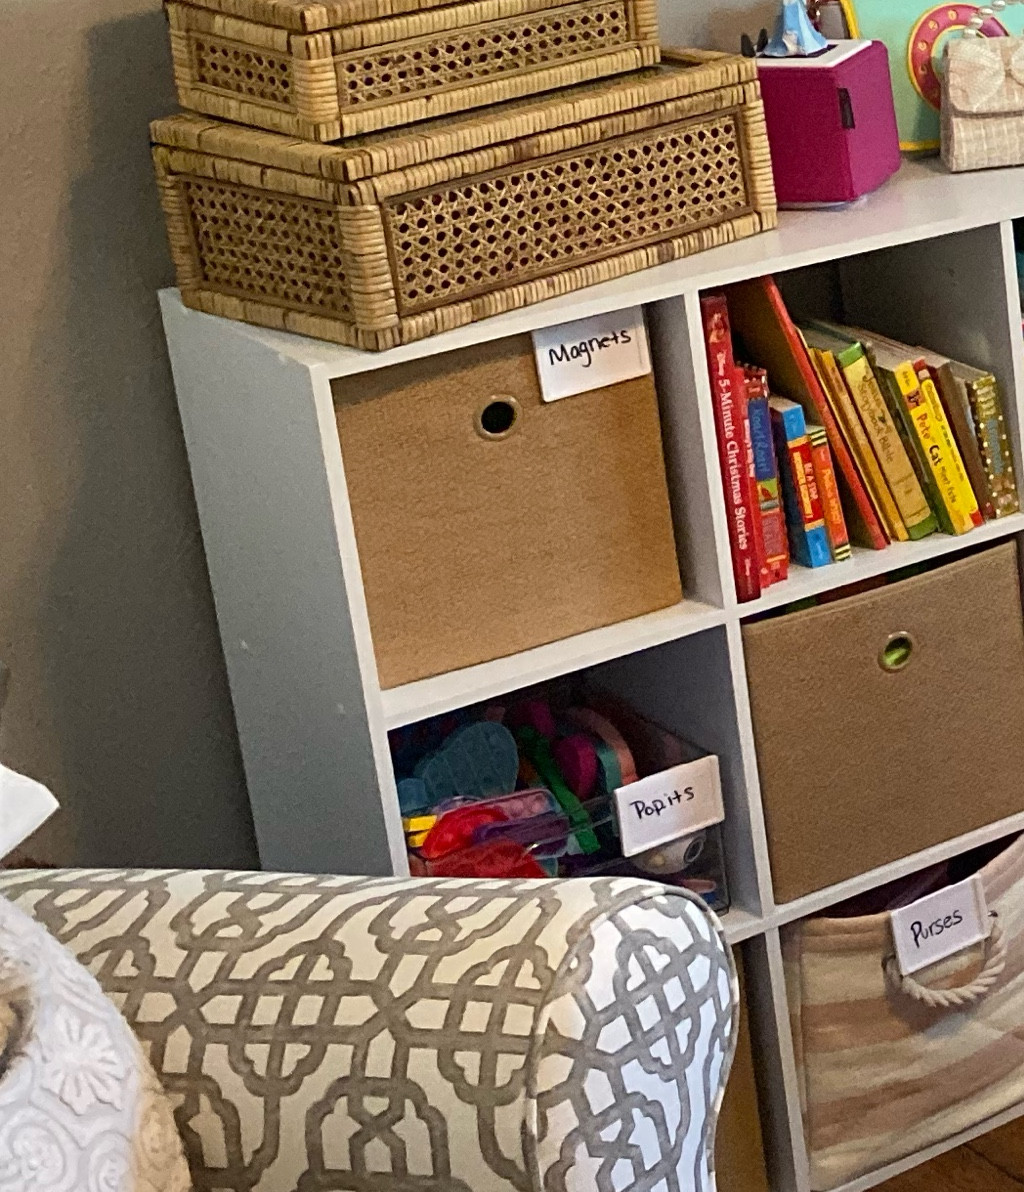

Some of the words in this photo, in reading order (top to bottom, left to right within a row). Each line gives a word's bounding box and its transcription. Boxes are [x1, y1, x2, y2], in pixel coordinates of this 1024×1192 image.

[548, 329, 632, 368] Magnets
[717, 378, 737, 439] 5-Minute
[857, 381, 886, 438] Storybook
[914, 412, 936, 440] Pete
[926, 443, 945, 467] Cat
[724, 440, 745, 504] Christmas
[807, 481, 819, 500] STAR
[733, 506, 750, 550] Stories
[910, 909, 963, 948] Purses
